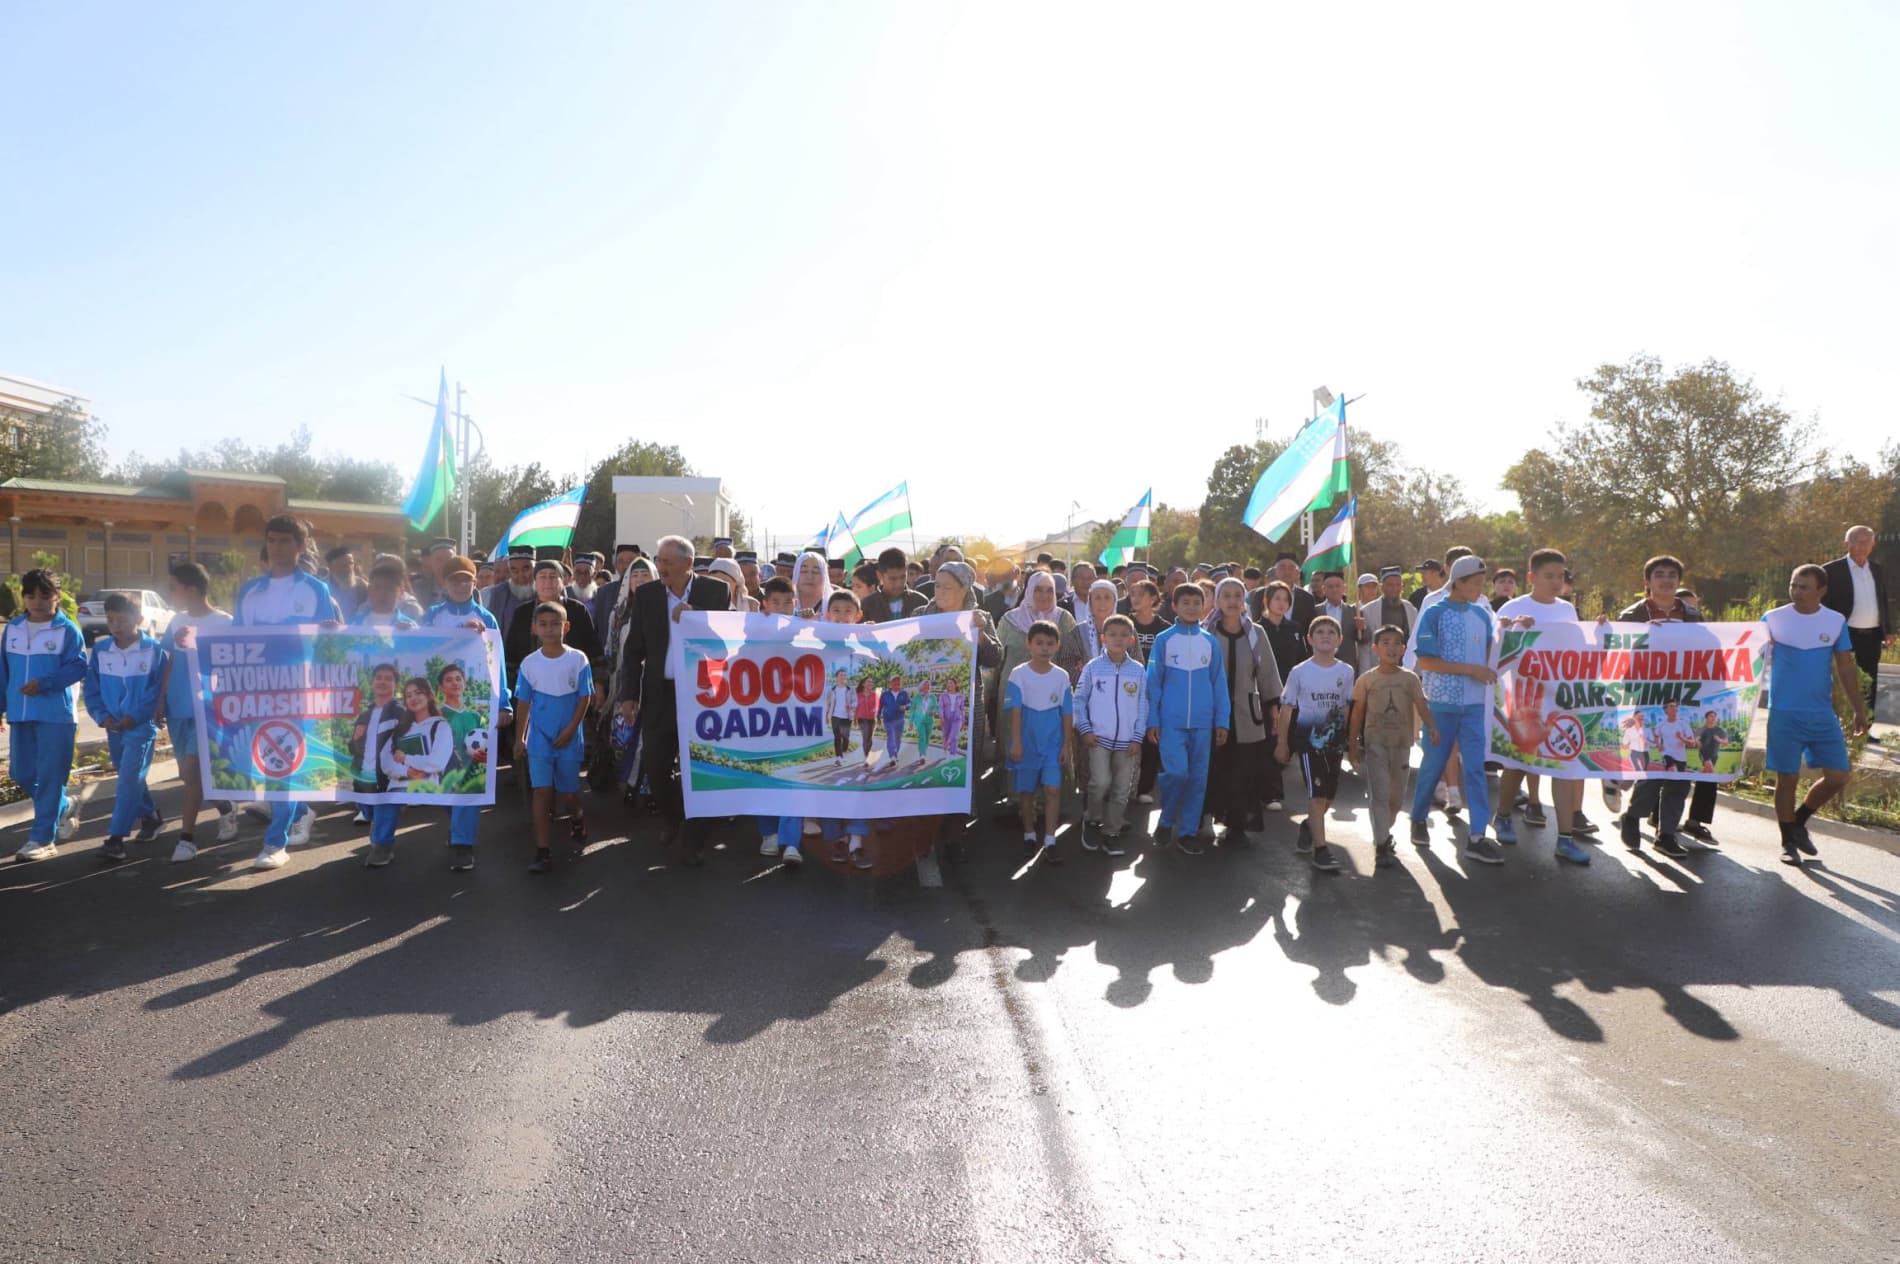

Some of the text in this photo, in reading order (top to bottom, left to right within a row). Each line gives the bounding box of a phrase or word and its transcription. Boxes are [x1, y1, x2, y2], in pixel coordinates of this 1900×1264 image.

[210, 643, 266, 665] BIZ
[1603, 632, 1649, 650] BIZ
[695, 653, 826, 708] 5000
[221, 691, 355, 721] QARSHIMIZ
[1555, 681, 1702, 710] QARSHIMIZ
[695, 706, 823, 741] QADAM
